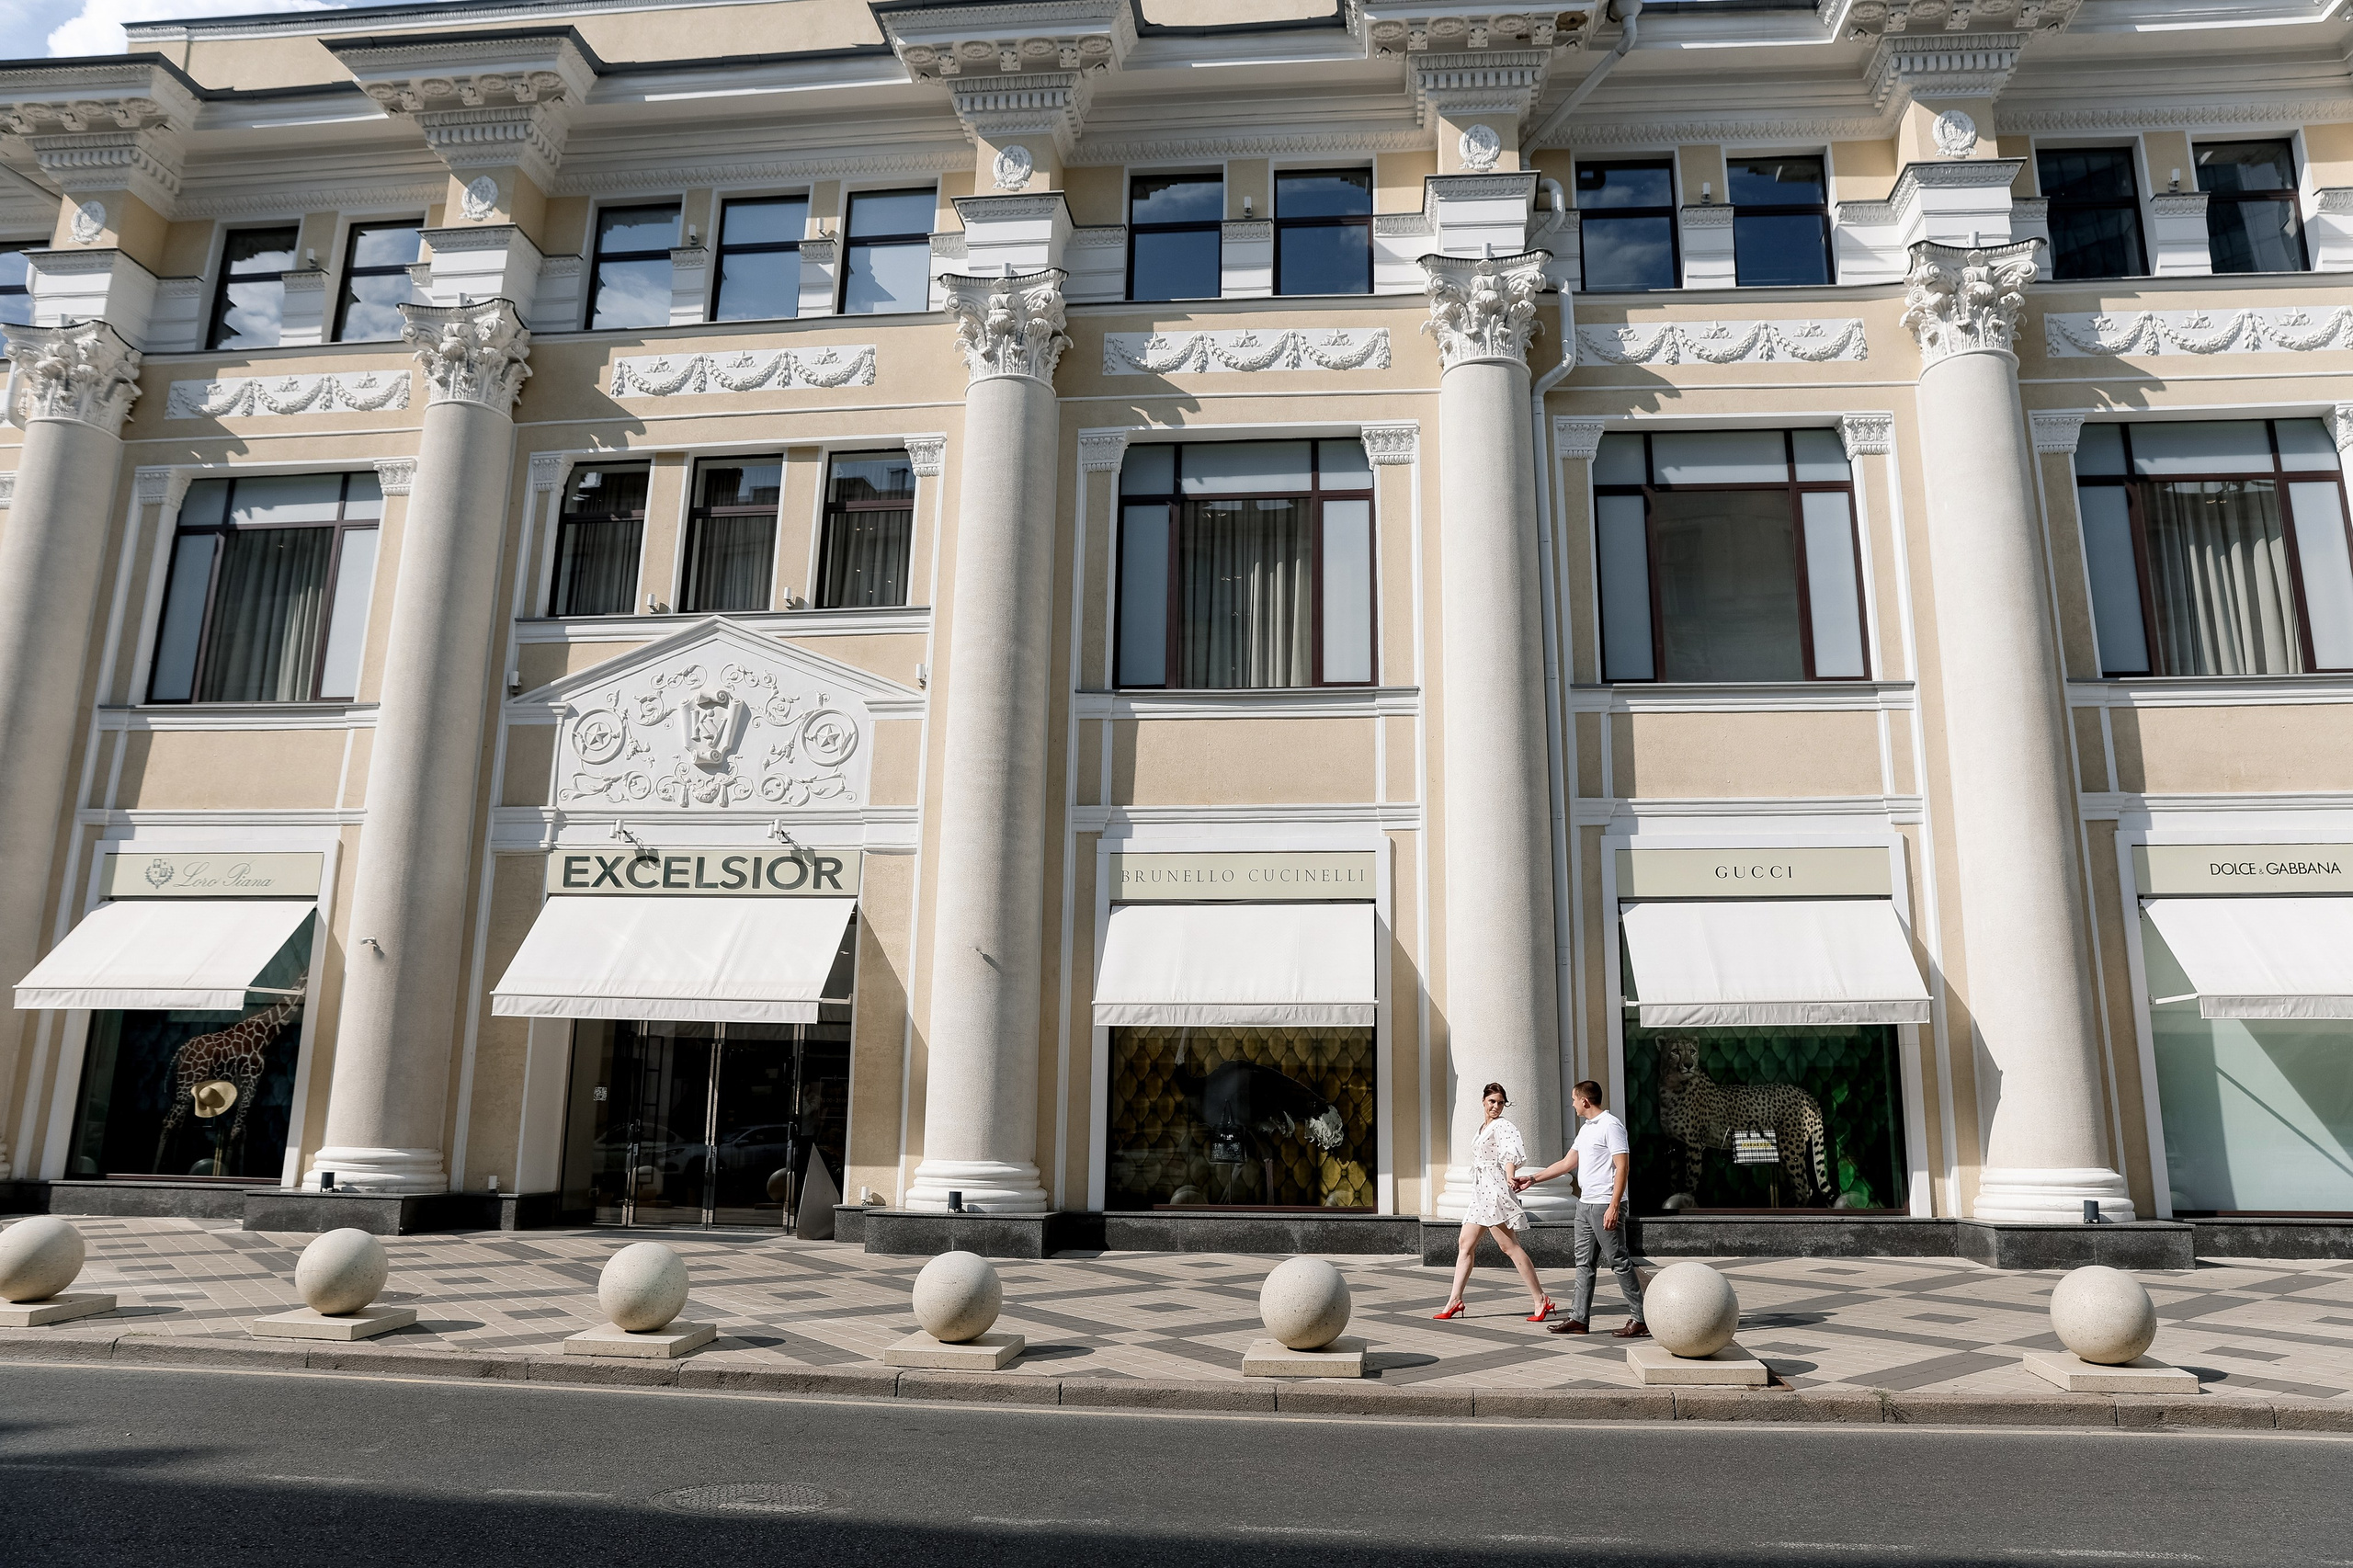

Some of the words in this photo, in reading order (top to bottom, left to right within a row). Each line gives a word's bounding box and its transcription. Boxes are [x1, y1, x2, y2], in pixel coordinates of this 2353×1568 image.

[173, 861, 220, 888] Loro
[222, 859, 276, 888] Piana
[563, 855, 844, 890] EXCELSIOR
[1120, 869, 1235, 883] BRUNELLO
[1248, 869, 1366, 882] CUCINELLI
[1714, 865, 1793, 879] GUCCI
[2210, 862, 2256, 876] DOLCE
[2266, 861, 2342, 875] GABBANA
